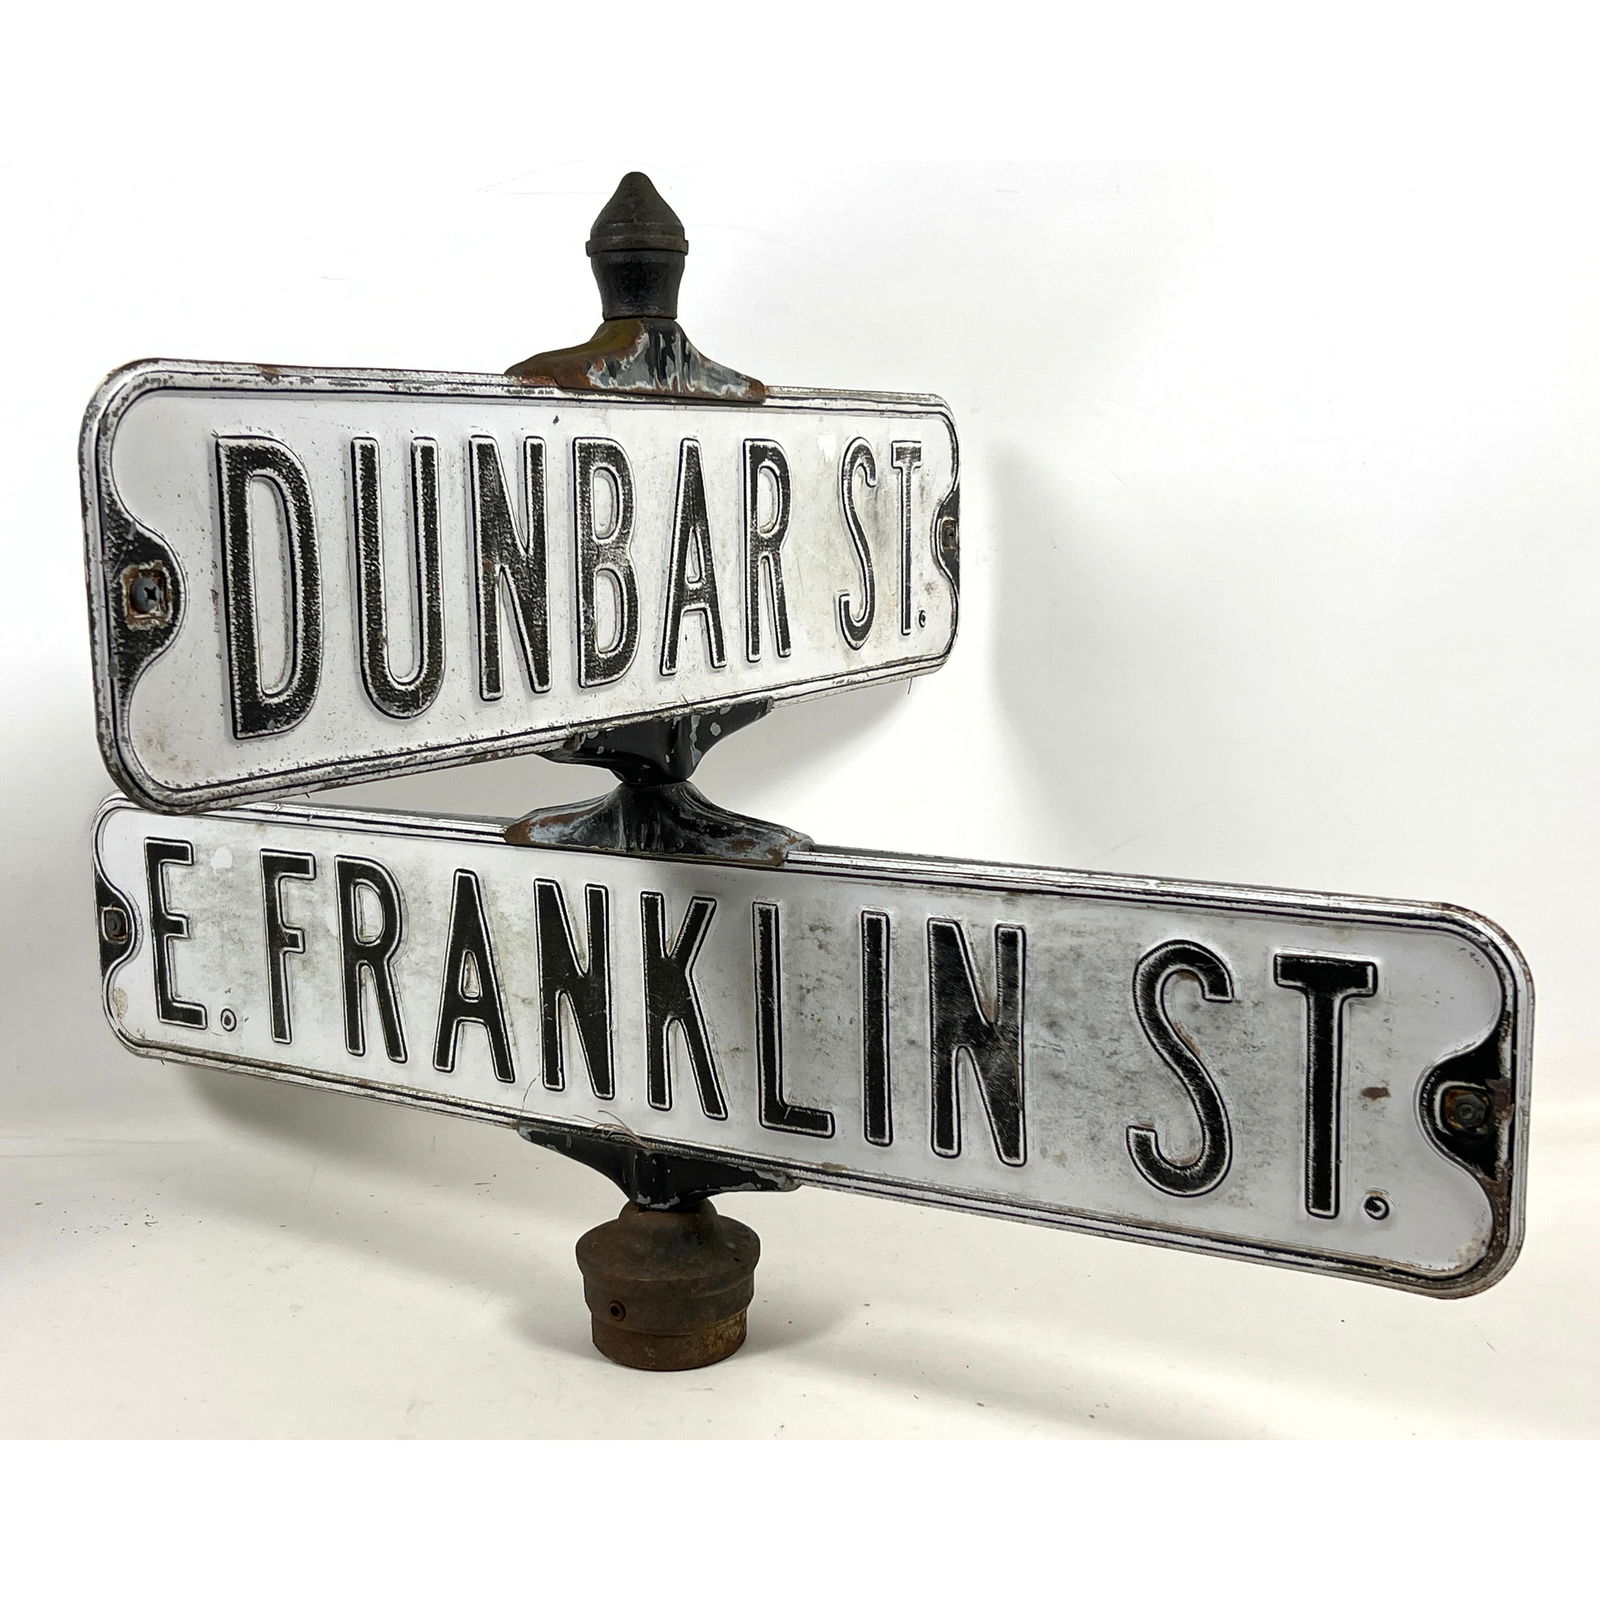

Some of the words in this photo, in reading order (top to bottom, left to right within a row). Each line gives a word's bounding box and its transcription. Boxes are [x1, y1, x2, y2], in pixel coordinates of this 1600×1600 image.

[215, 435, 792, 741] DUNBAR
[838, 436, 928, 650] ST.
[144, 837, 238, 1033] E.
[260, 849, 1028, 1167] FRANKLIN
[1125, 938, 1390, 1220] ST.
